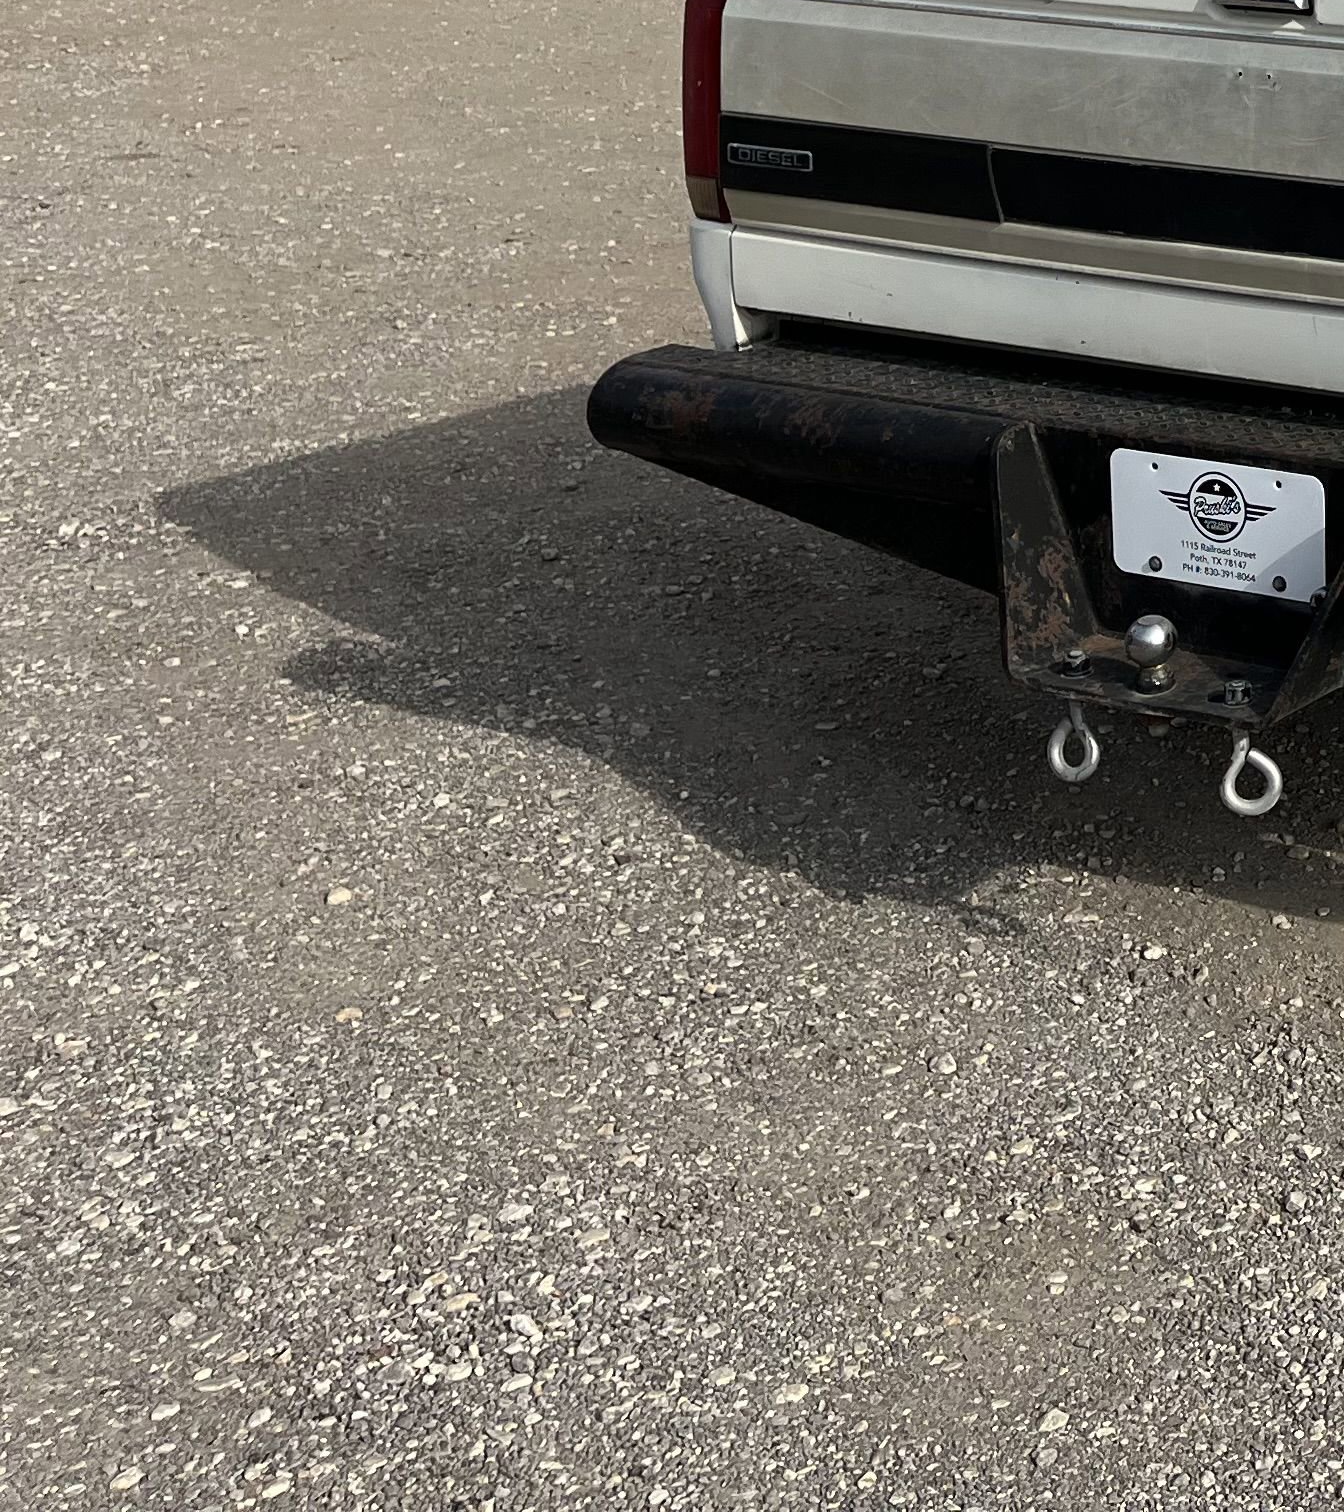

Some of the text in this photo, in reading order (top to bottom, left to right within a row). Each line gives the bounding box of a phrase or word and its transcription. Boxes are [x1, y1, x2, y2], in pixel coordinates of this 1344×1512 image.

[738, 148, 803, 167] DIESEL
[1193, 495, 1242, 518] Pruski's
[1181, 540, 1257, 560] 1115 Railroad Street
[1182, 563, 1194, 573] PH
[1204, 567, 1257, 583] 830-391-8064
[1211, 556, 1222, 566] TX
[1224, 558, 1247, 570] 78147
